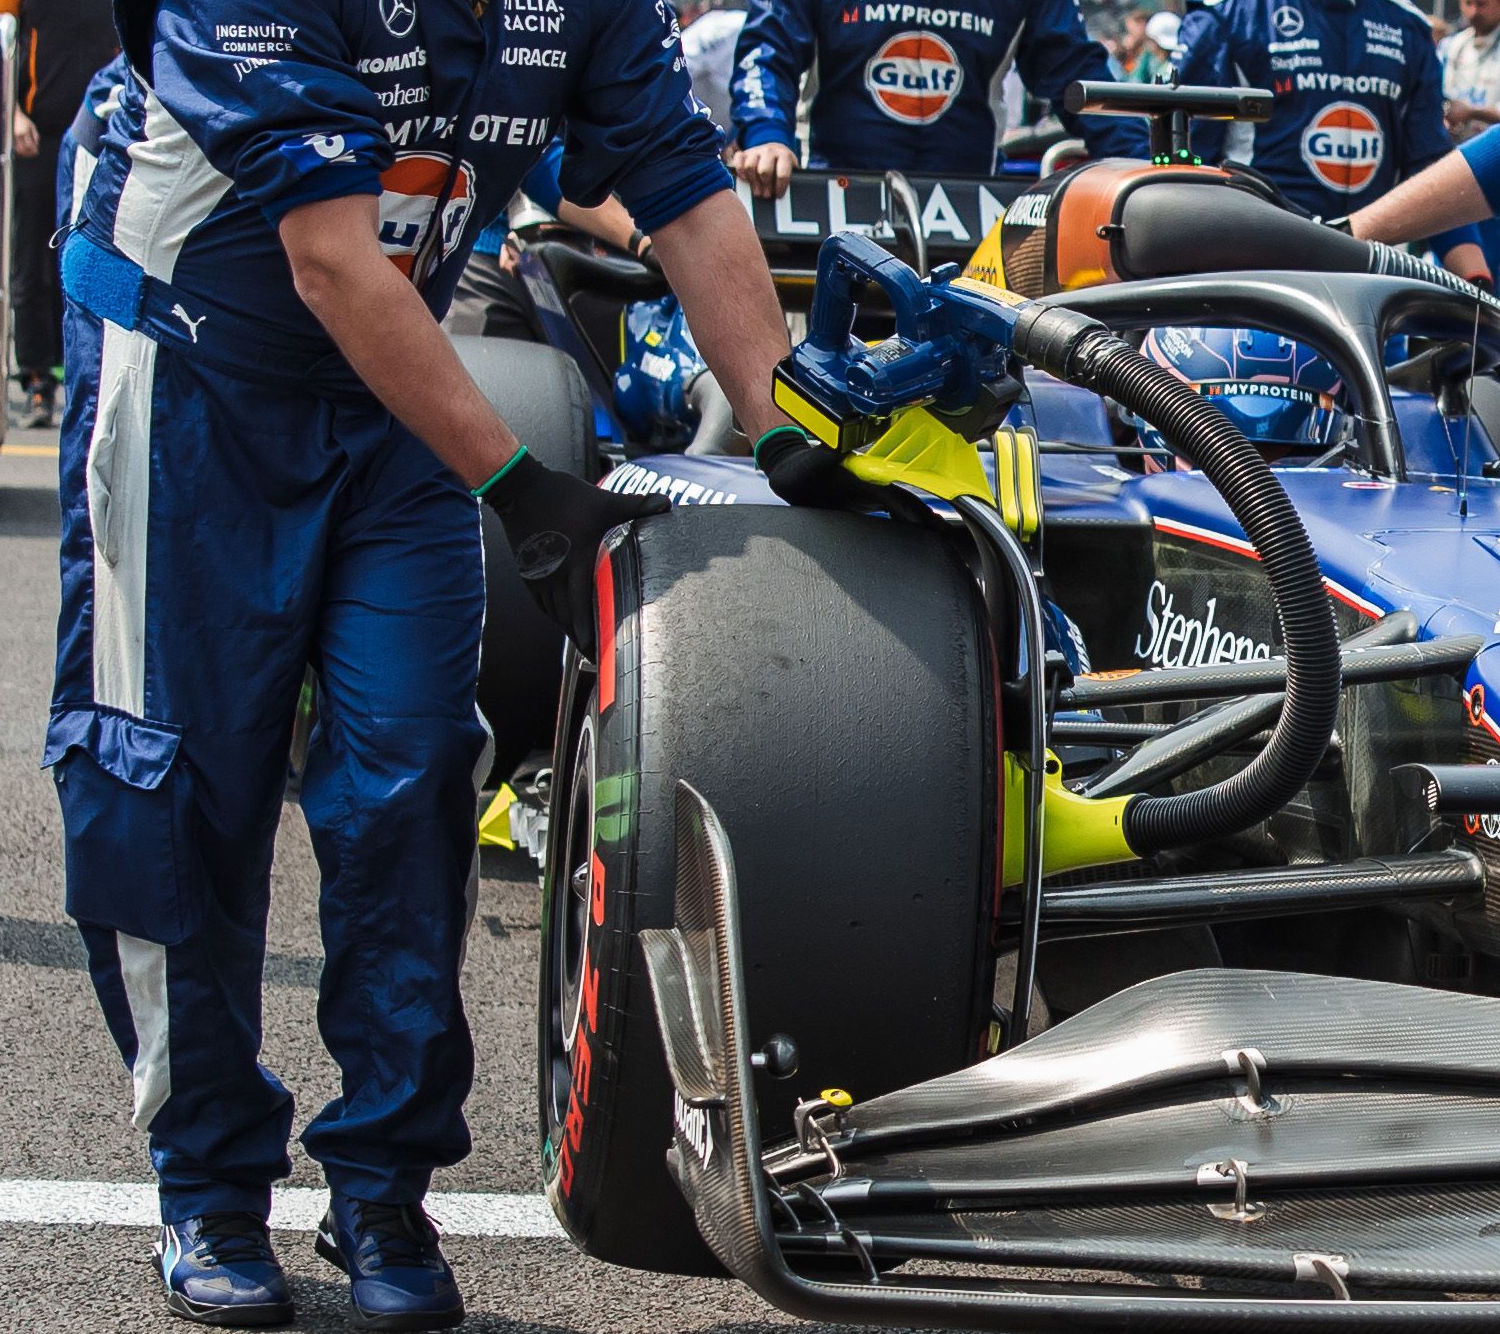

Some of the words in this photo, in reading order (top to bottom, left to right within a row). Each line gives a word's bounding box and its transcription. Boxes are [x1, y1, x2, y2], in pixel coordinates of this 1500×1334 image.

[864, 3, 995, 36] MYPROTEIN
[223, 42, 293, 53] COMMERCE
[871, 61, 957, 92] Gulf
[1308, 132, 1379, 160] Gulf
[1224, 383, 1313, 403] MYPROTEIN
